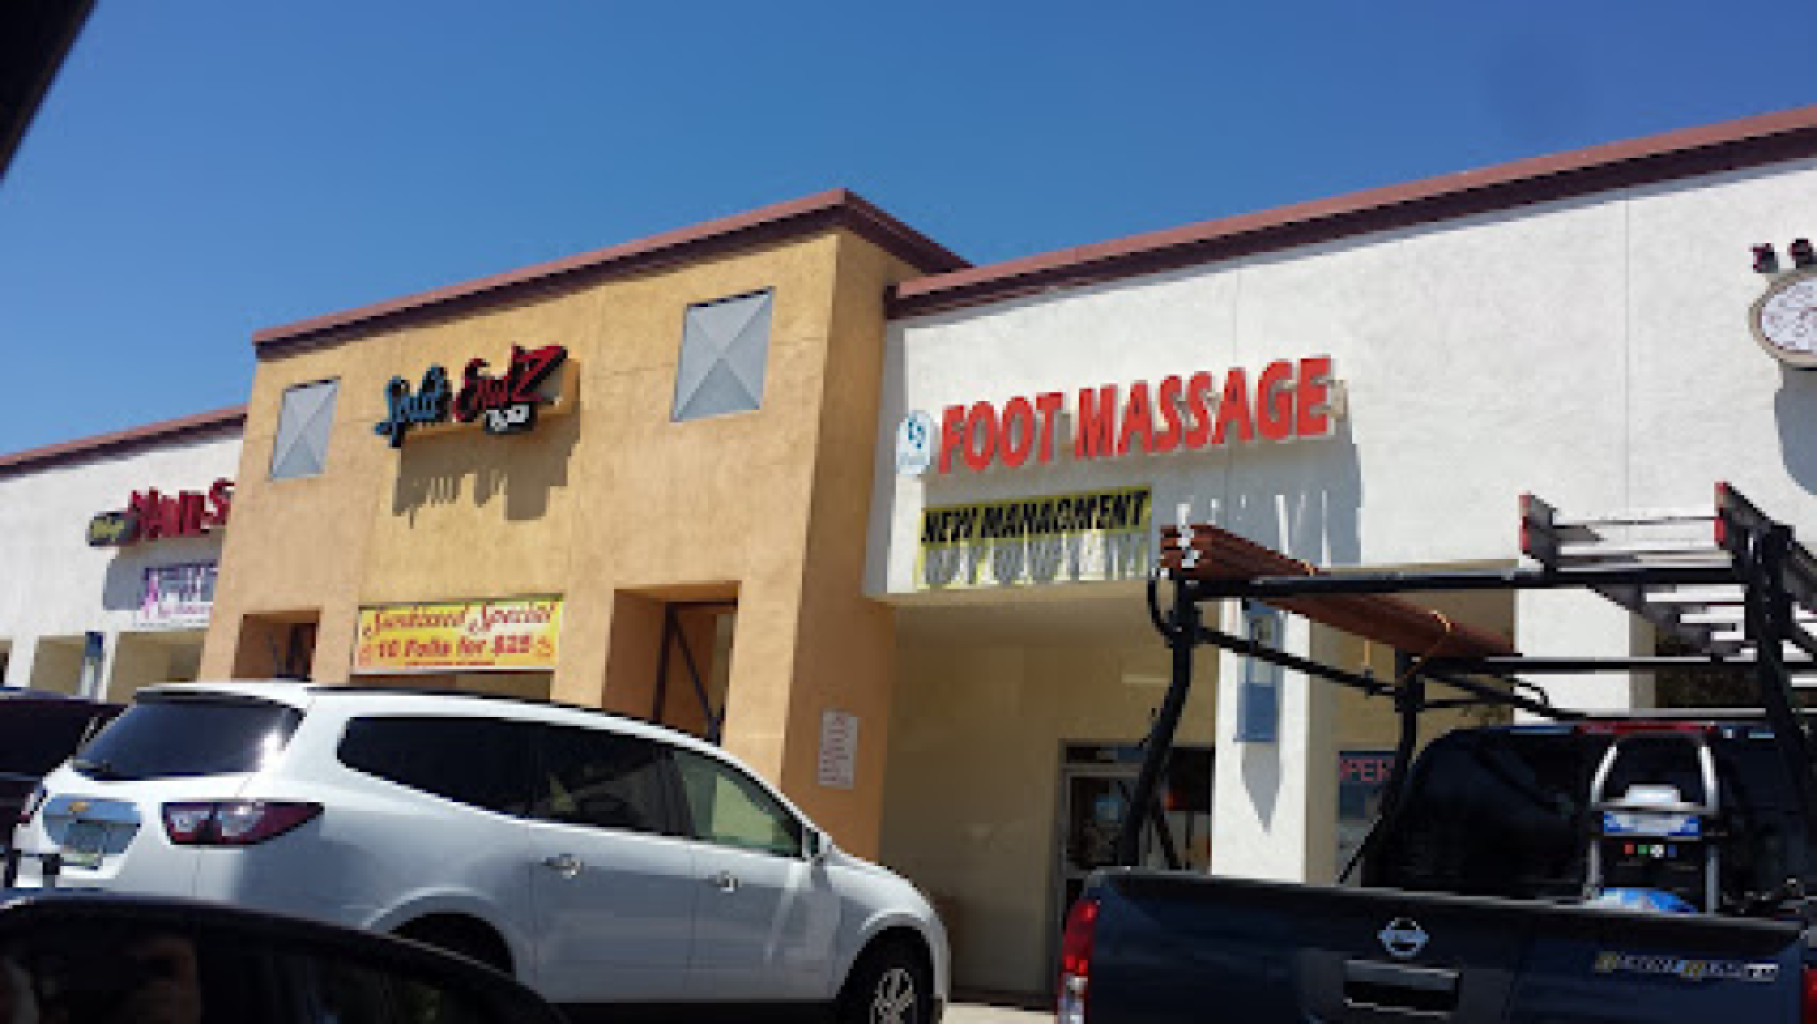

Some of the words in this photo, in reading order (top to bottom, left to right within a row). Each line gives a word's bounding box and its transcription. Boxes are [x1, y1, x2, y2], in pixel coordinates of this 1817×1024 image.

[938, 391, 1064, 475] FOOT
[1073, 354, 1332, 461] MASSAGE
[921, 507, 977, 542] NEW
[980, 489, 1150, 538] MANAGMENT
